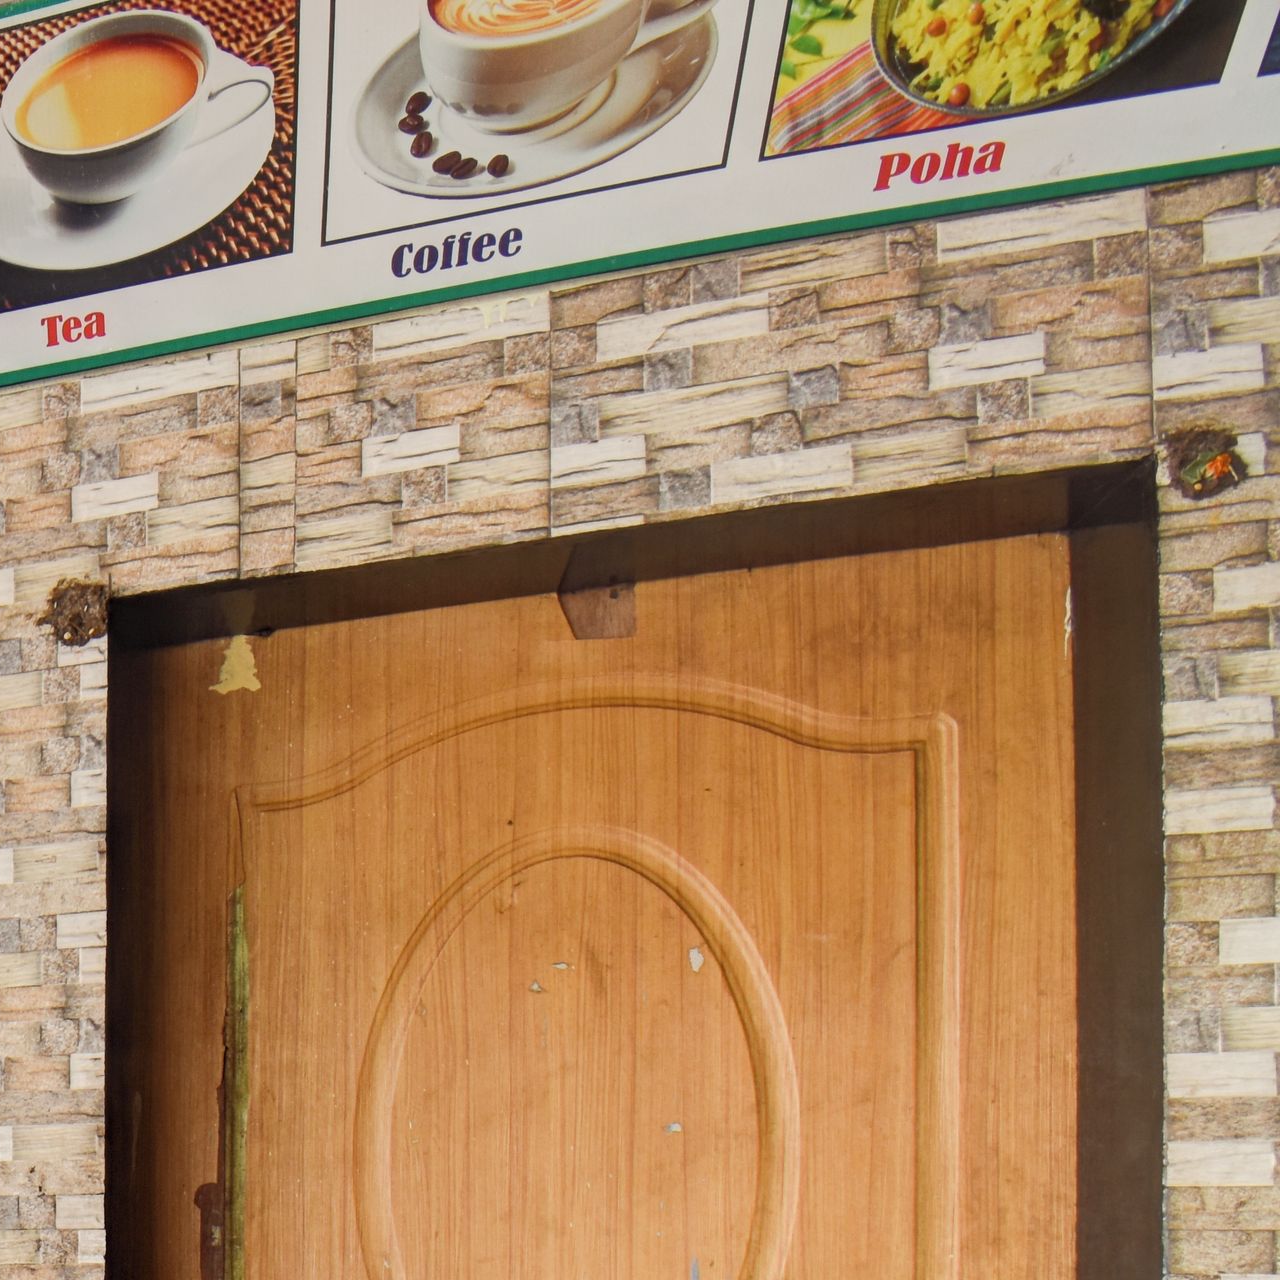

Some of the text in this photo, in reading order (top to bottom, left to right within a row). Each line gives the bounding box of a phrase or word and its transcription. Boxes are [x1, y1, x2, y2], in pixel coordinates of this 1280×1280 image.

[873, 141, 1006, 192] Poha
[391, 227, 523, 279] Coffee
[40, 310, 106, 347] Tea
